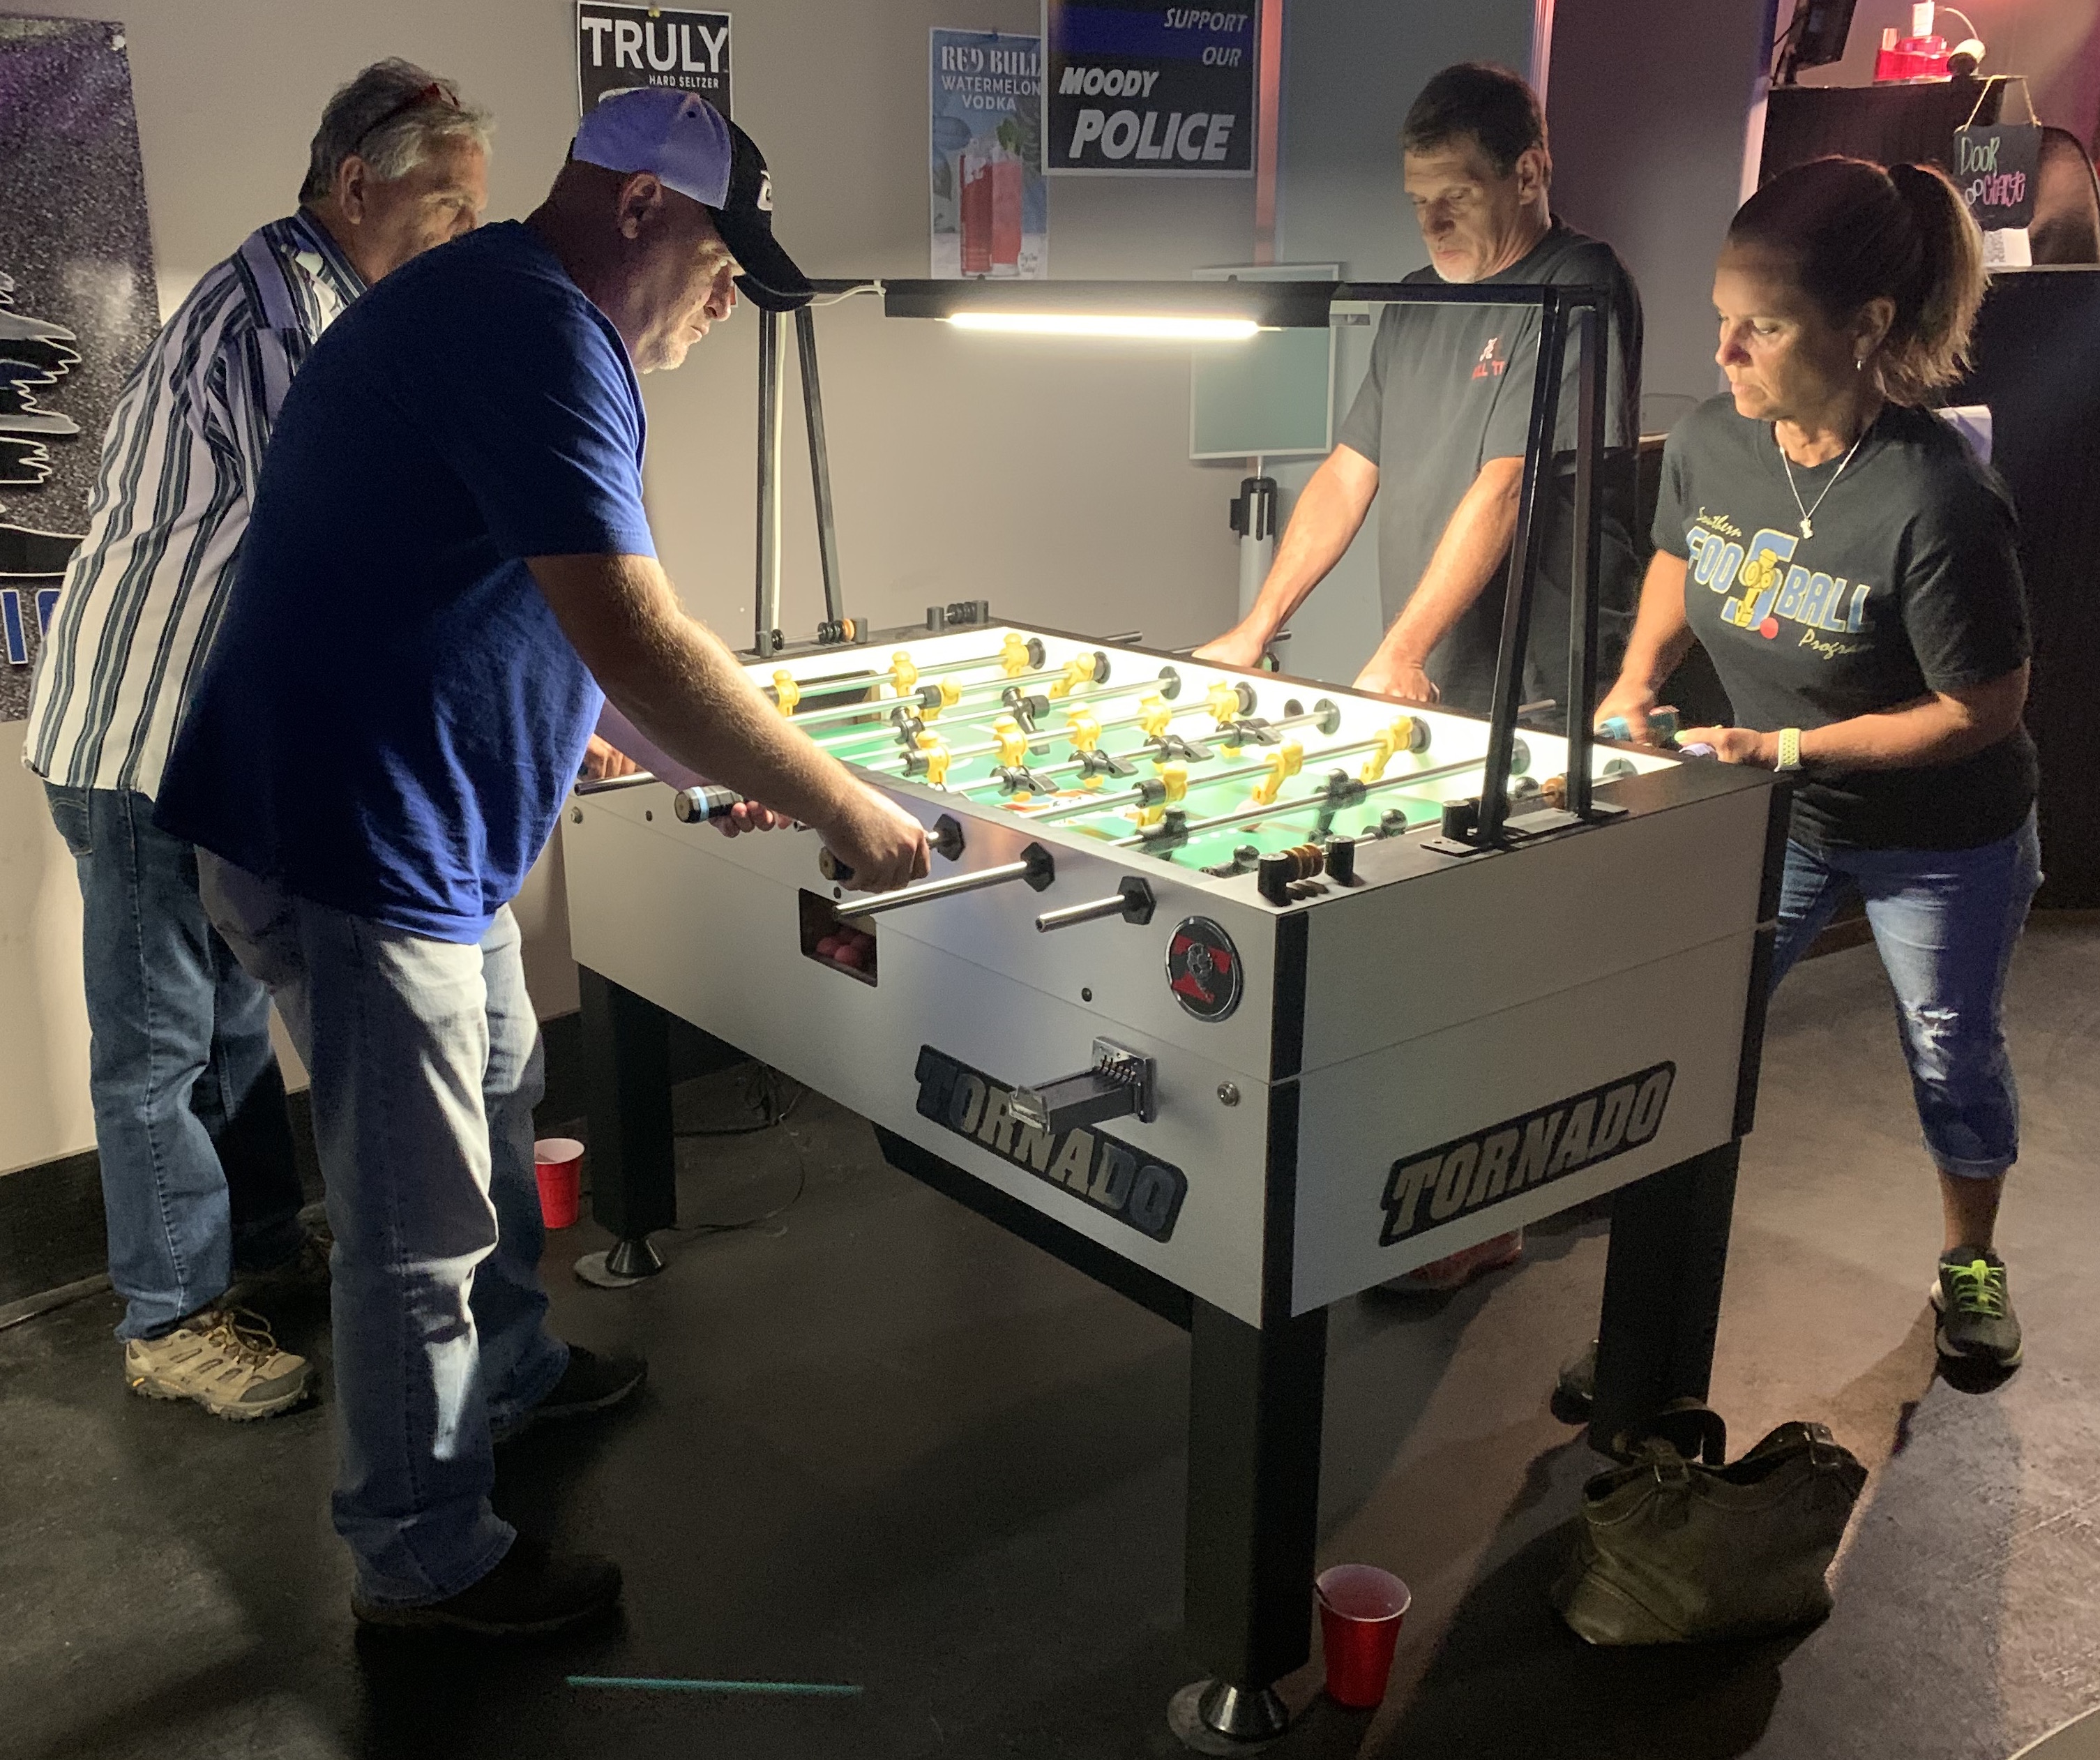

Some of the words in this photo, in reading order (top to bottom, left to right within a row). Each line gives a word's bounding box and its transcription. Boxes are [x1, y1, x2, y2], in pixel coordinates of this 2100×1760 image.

[1163, 7, 1248, 33] SUPPORT
[582, 17, 728, 73] TRULY
[1202, 46, 1242, 68] OUR
[942, 45, 984, 73] RED
[990, 50, 1041, 77] BULL
[649, 74, 677, 88] HARD
[679, 75, 719, 89] SELTZER
[942, 75, 1041, 96] WATERMELON
[1058, 66, 1161, 98] MOODY
[962, 94, 1017, 112] VODKA
[1068, 109, 1236, 161] POLICE
[1391, 1069, 1671, 1235] TORNADO
